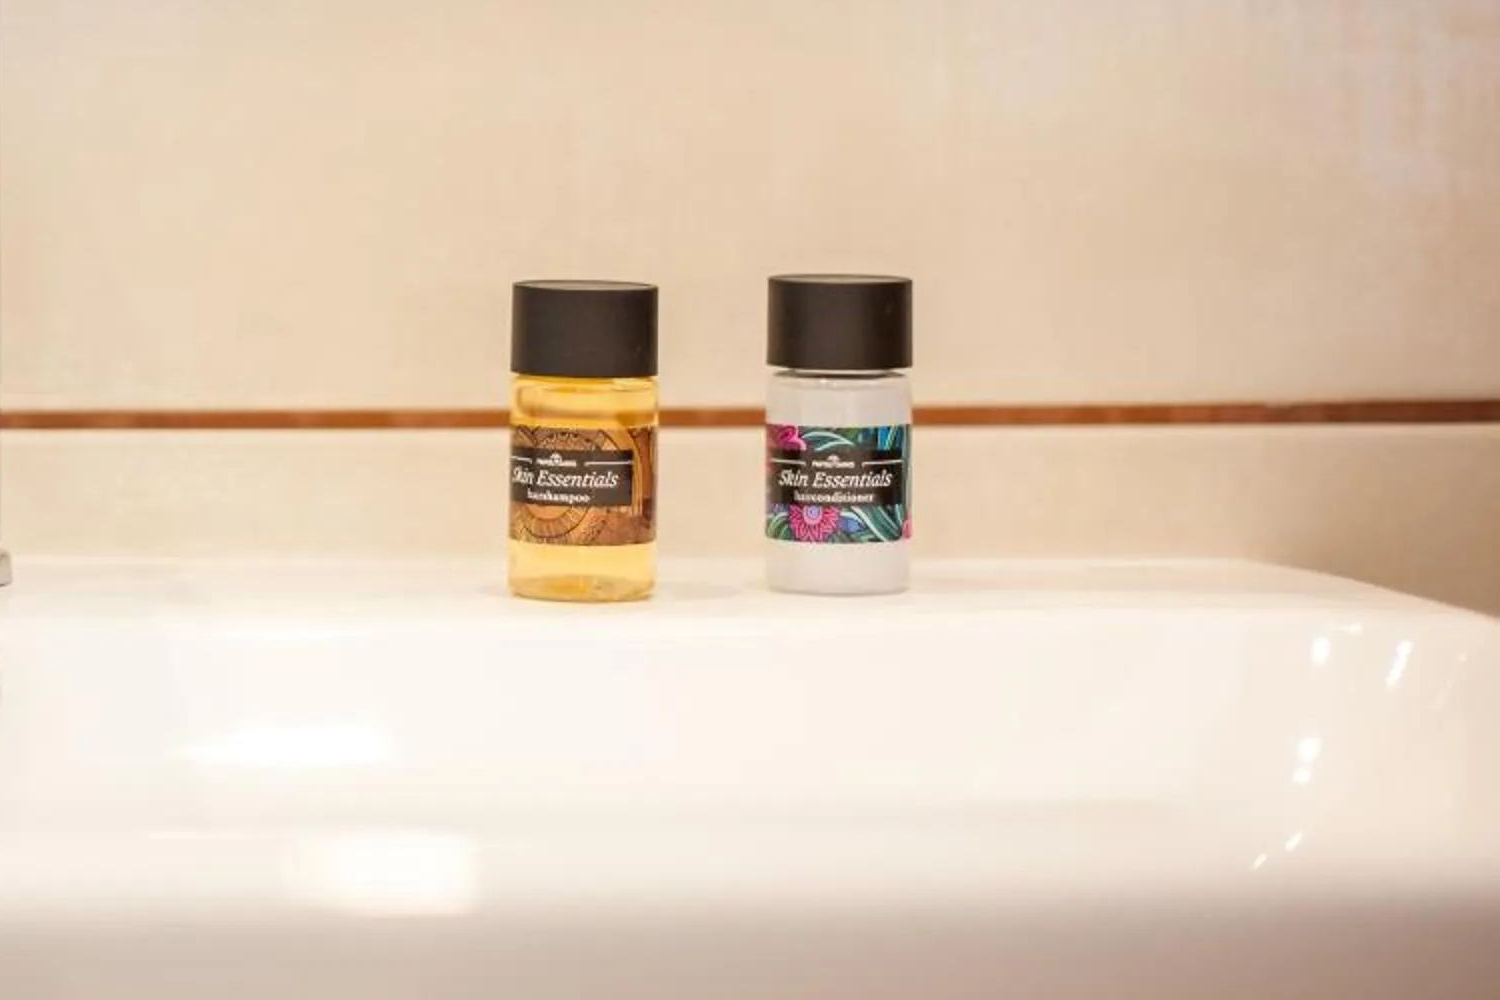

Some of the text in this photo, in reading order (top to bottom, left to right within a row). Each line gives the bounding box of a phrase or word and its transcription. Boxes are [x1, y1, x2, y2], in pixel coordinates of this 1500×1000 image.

[536, 470, 618, 487] Essentials
[779, 469, 893, 488] Skin Essentials
